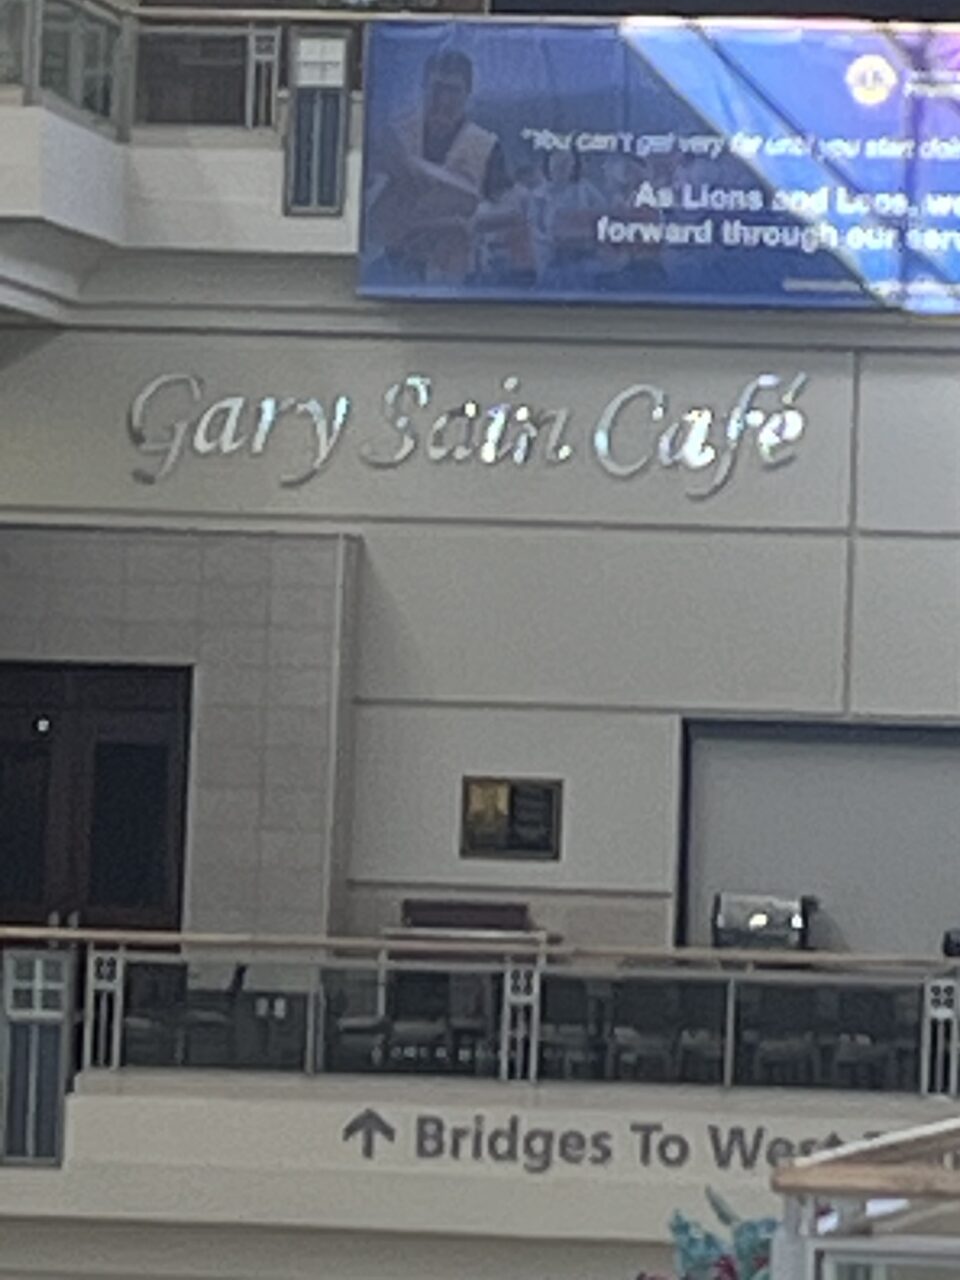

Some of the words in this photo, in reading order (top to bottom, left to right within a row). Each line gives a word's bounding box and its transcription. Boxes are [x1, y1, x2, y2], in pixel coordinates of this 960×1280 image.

[634, 181, 673, 208] As
[682, 184, 763, 211] Lions
[771, 186, 829, 215] and
[596, 217, 712, 246] forward
[722, 220, 838, 253] through
[127, 370, 351, 489] Gary
[358, 374, 573, 470] Sain
[593, 370, 808, 501] Café
[414, 1115, 614, 1174] Bridges
[629, 1123, 691, 1168] To
